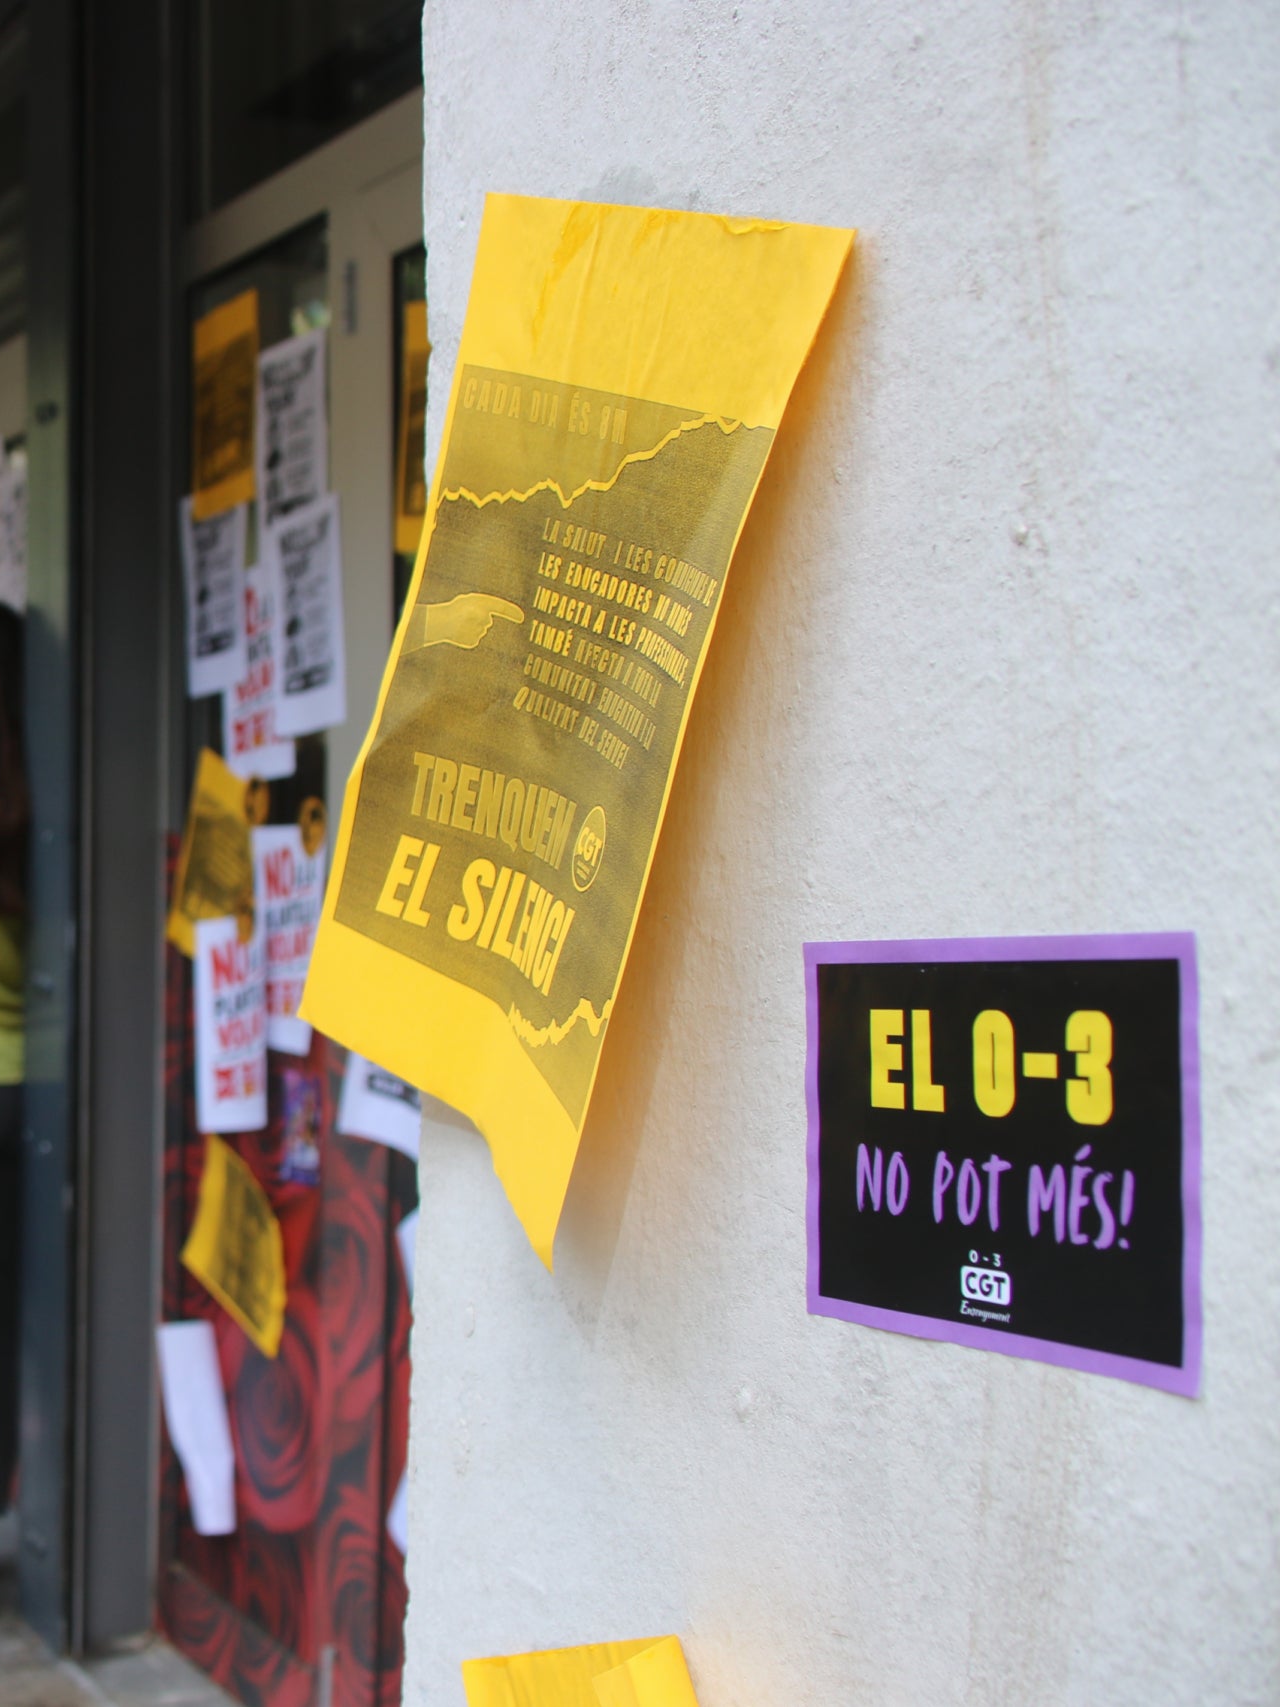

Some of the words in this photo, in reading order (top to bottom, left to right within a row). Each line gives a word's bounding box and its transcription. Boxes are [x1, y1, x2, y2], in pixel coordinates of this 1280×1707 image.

[463, 378, 520, 418] CADA
[528, 389, 560, 428] DIA
[568, 391, 591, 435] ÉS
[542, 517, 560, 543] LA
[562, 524, 607, 558] SALUT
[613, 540, 623, 564] I
[624, 543, 652, 574] LES
[532, 585, 592, 628] IMPACTA
[592, 609, 607, 634] A
[608, 615, 636, 646] LES
[538, 551, 562, 580] LES
[564, 561, 653, 614] EDUCADORES
[652, 593, 671, 622] NO
[523, 653, 598, 705] COMUNITAT
[529, 619, 574, 657] TAMBÉ
[574, 639, 625, 680] AFECTA
[513, 686, 580, 733] QUALITAT
[578, 716, 600, 747] DEL
[411, 752, 578, 870] TRENQUEM
[577, 826, 603, 867] CGT
[376, 835, 441, 927] EL
[446, 859, 575, 996] SILENCI
[870, 1009, 945, 1112] EL
[972, 1009, 1113, 1125] 0-3
[856, 1143, 910, 1216] NO
[932, 1150, 1012, 1232] POT
[1027, 1144, 1134, 1250] MÉS!
[965, 1271, 1006, 1299] CGT
